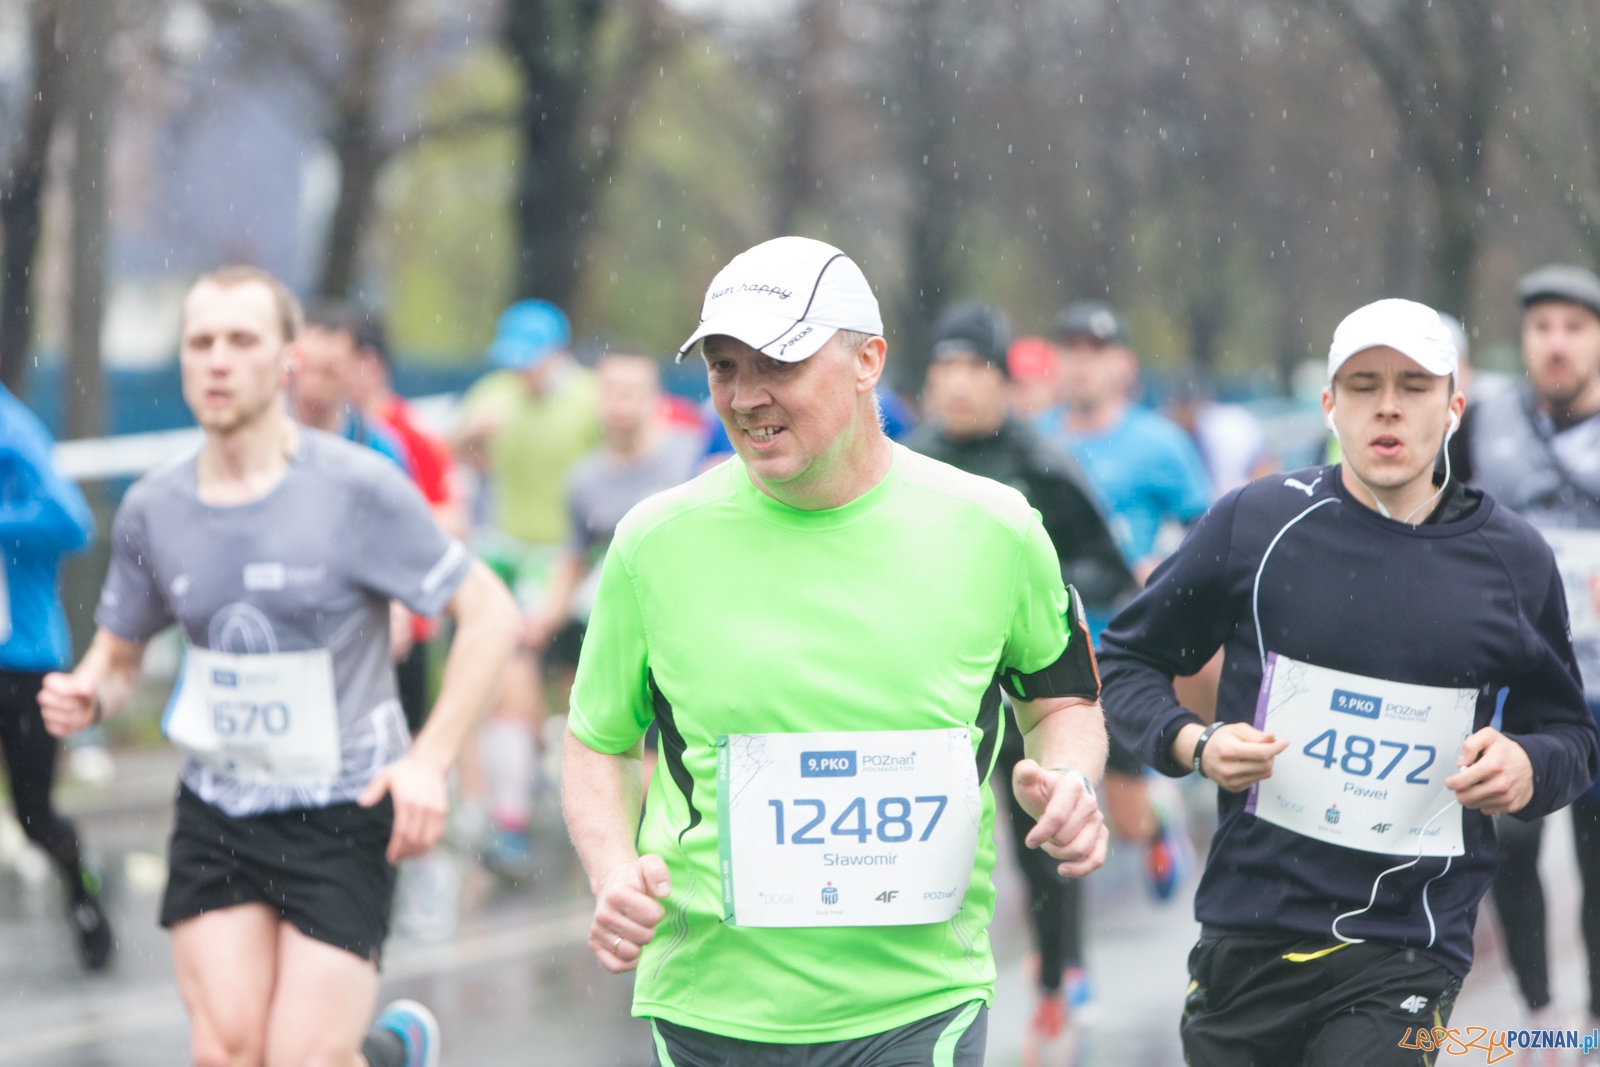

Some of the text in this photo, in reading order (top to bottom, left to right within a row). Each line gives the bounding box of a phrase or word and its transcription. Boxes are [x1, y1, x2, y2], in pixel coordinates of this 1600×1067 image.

[711, 281, 793, 300] run happy
[787, 325, 814, 347] BROOKS
[1302, 728, 1437, 785] 4872
[1342, 782, 1389, 801] Paweł
[768, 795, 948, 845] 12487
[1370, 822, 1393, 834] 4F
[823, 852, 898, 867] Sławomir
[875, 890, 900, 903] 4F
[1400, 995, 1429, 1014] 4F
